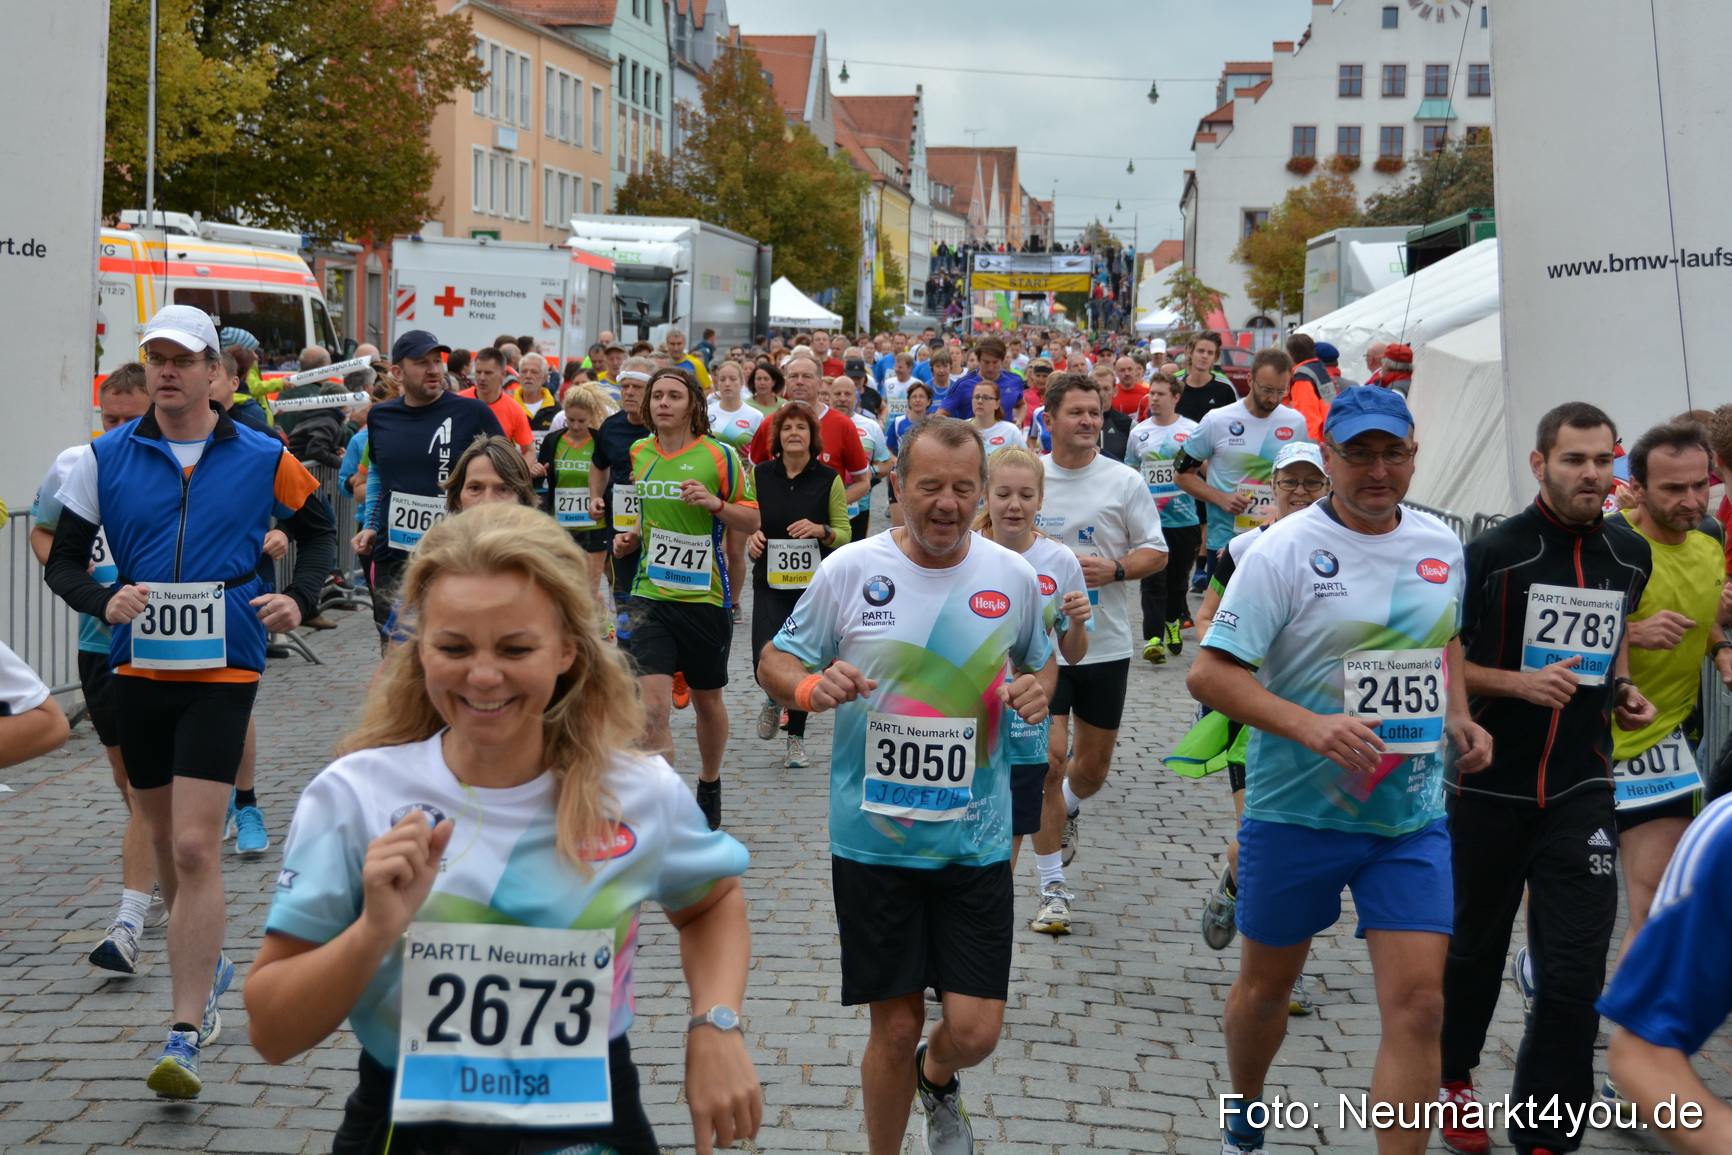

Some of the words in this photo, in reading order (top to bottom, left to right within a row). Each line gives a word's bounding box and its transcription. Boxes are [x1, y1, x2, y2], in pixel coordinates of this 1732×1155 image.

[1009, 278, 1050, 287] START
[470, 287, 527, 299] Bayerisches
[470, 299, 496, 309] Rotes
[469, 311, 496, 320] Kreuz
[773, 316, 811, 325] Laufsport
[1149, 469, 1175, 484] 263
[393, 497, 411, 505] PARTL
[412, 501, 441, 509] Neumarkt
[652, 533, 672, 543] PARTL
[673, 537, 703, 546] Neumarkt
[654, 544, 707, 570] 2747
[778, 552, 812, 570] 369
[665, 571, 692, 583] Simon
[1313, 582, 1347, 592] PARTL
[164, 592, 209, 600] Neumarkt
[1314, 591, 1348, 599] Neumarkt
[1531, 593, 1567, 605] PARTL
[1569, 597, 1614, 609] Neumarkt
[975, 596, 1006, 612] Hervis
[140, 603, 214, 636] 3001
[862, 611, 895, 620] PARTL
[1535, 608, 1616, 649] 2783
[1347, 660, 1385, 671] PARTL
[1387, 659, 1433, 671] Neumarkt
[1357, 674, 1439, 713] 2453
[869, 721, 904, 735] PARTL
[906, 726, 960, 738] Neumarkt
[1379, 723, 1424, 739] Lothar
[876, 738, 966, 782] 3050
[1626, 781, 1675, 797] Herbert
[1587, 839, 1611, 847] adidas
[1589, 854, 1613, 875] 35
[410, 943, 482, 962] PARTL
[488, 945, 587, 967] Neumarkt
[426, 972, 596, 1047] 2673
[460, 1067, 551, 1096] Denisa
